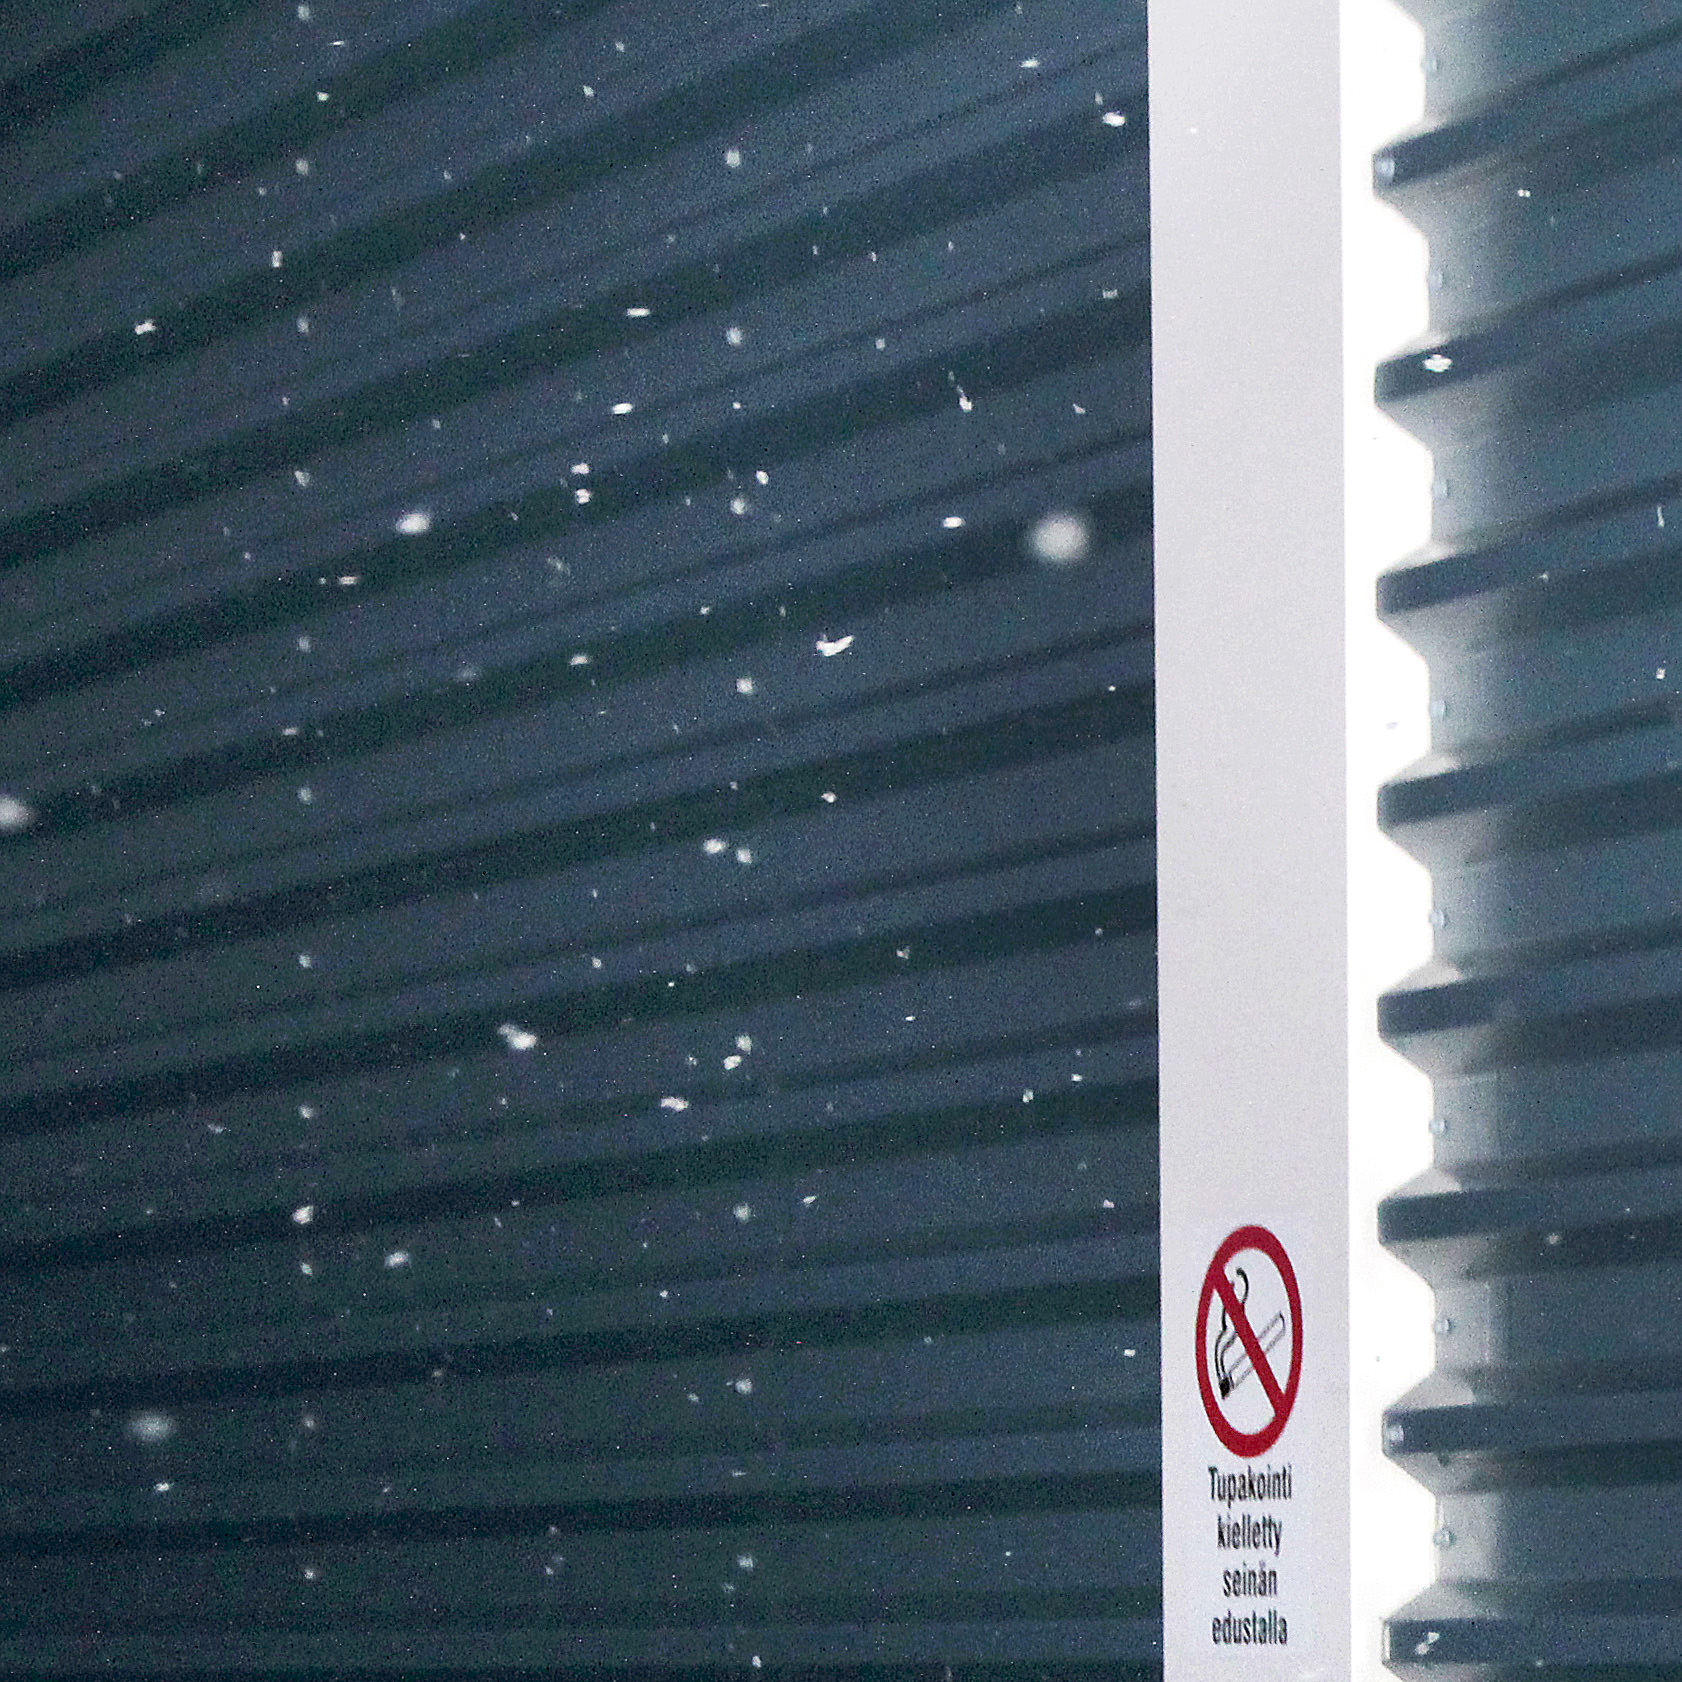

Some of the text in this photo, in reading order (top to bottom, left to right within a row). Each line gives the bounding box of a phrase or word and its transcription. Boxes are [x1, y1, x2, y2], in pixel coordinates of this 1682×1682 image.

[1207, 1463, 1292, 1509] Tupakointi
[1217, 1513, 1283, 1557] kielletty
[1222, 1560, 1278, 1597] seinän
[1212, 1609, 1288, 1645] edustalla
